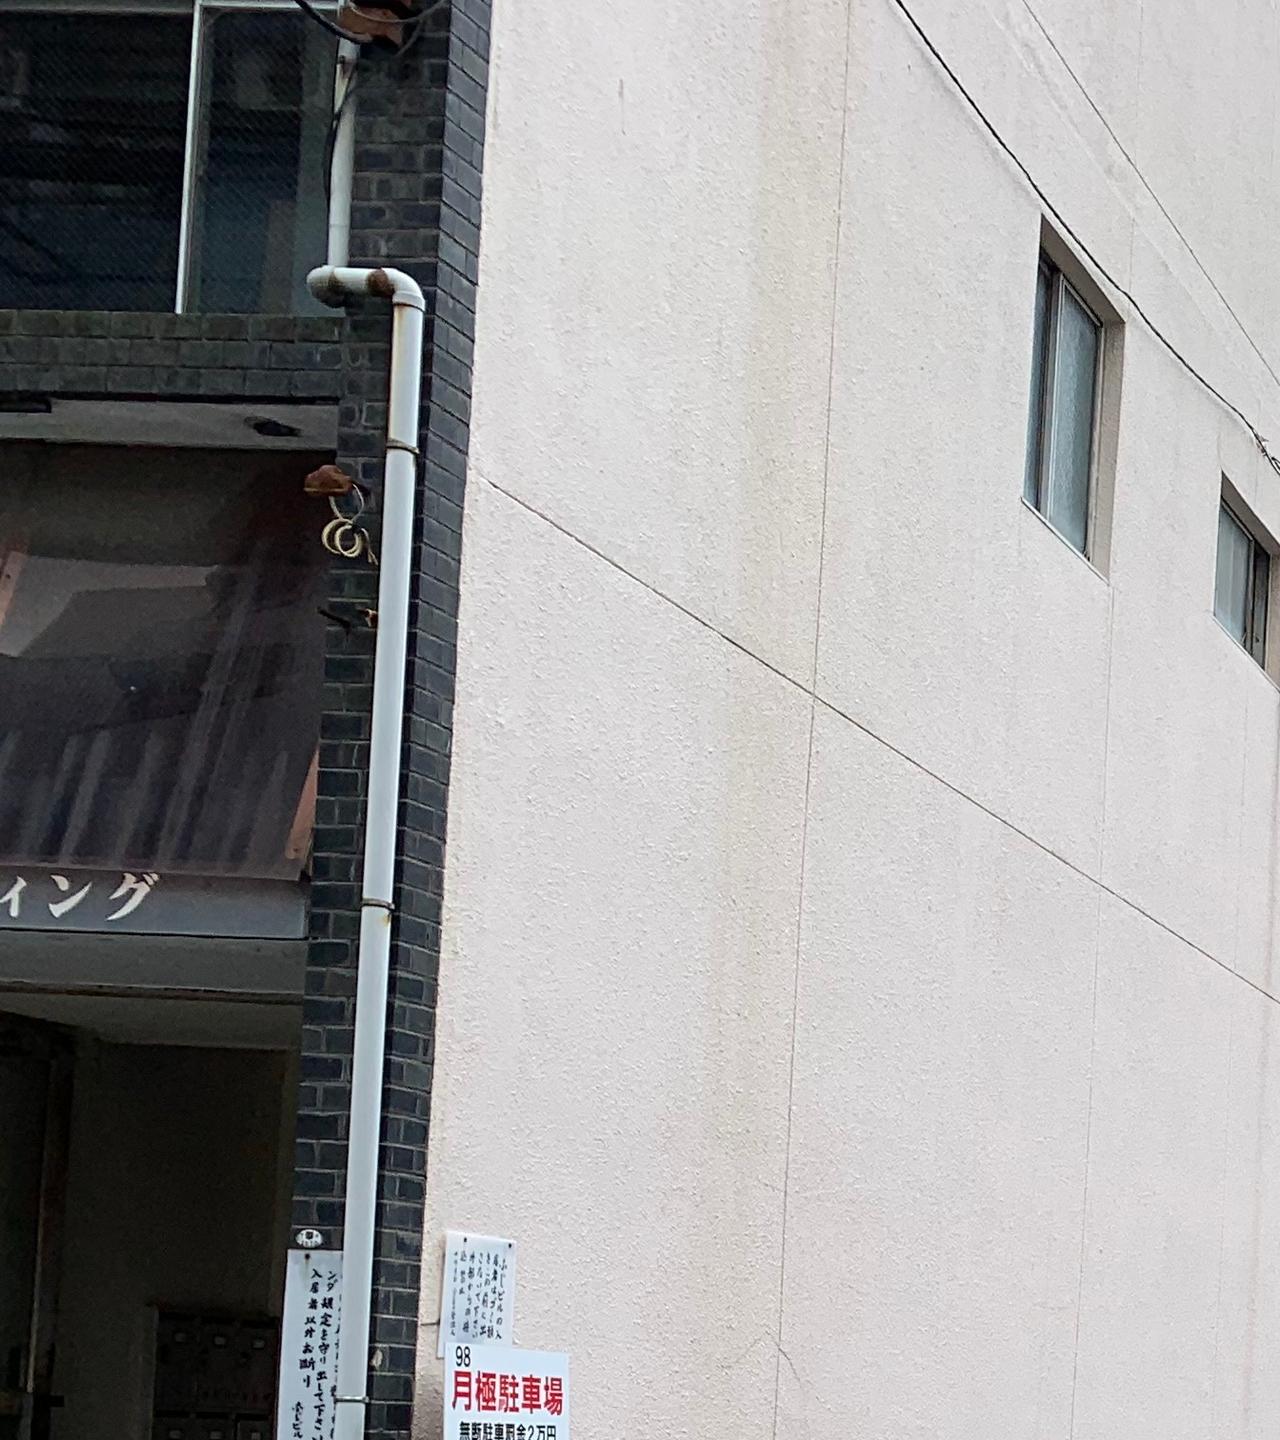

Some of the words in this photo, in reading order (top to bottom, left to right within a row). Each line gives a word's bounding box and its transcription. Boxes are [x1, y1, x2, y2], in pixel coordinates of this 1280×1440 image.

[455, 1346, 471, 1367] 98
[452, 1370, 563, 1416] 月極駐車場
